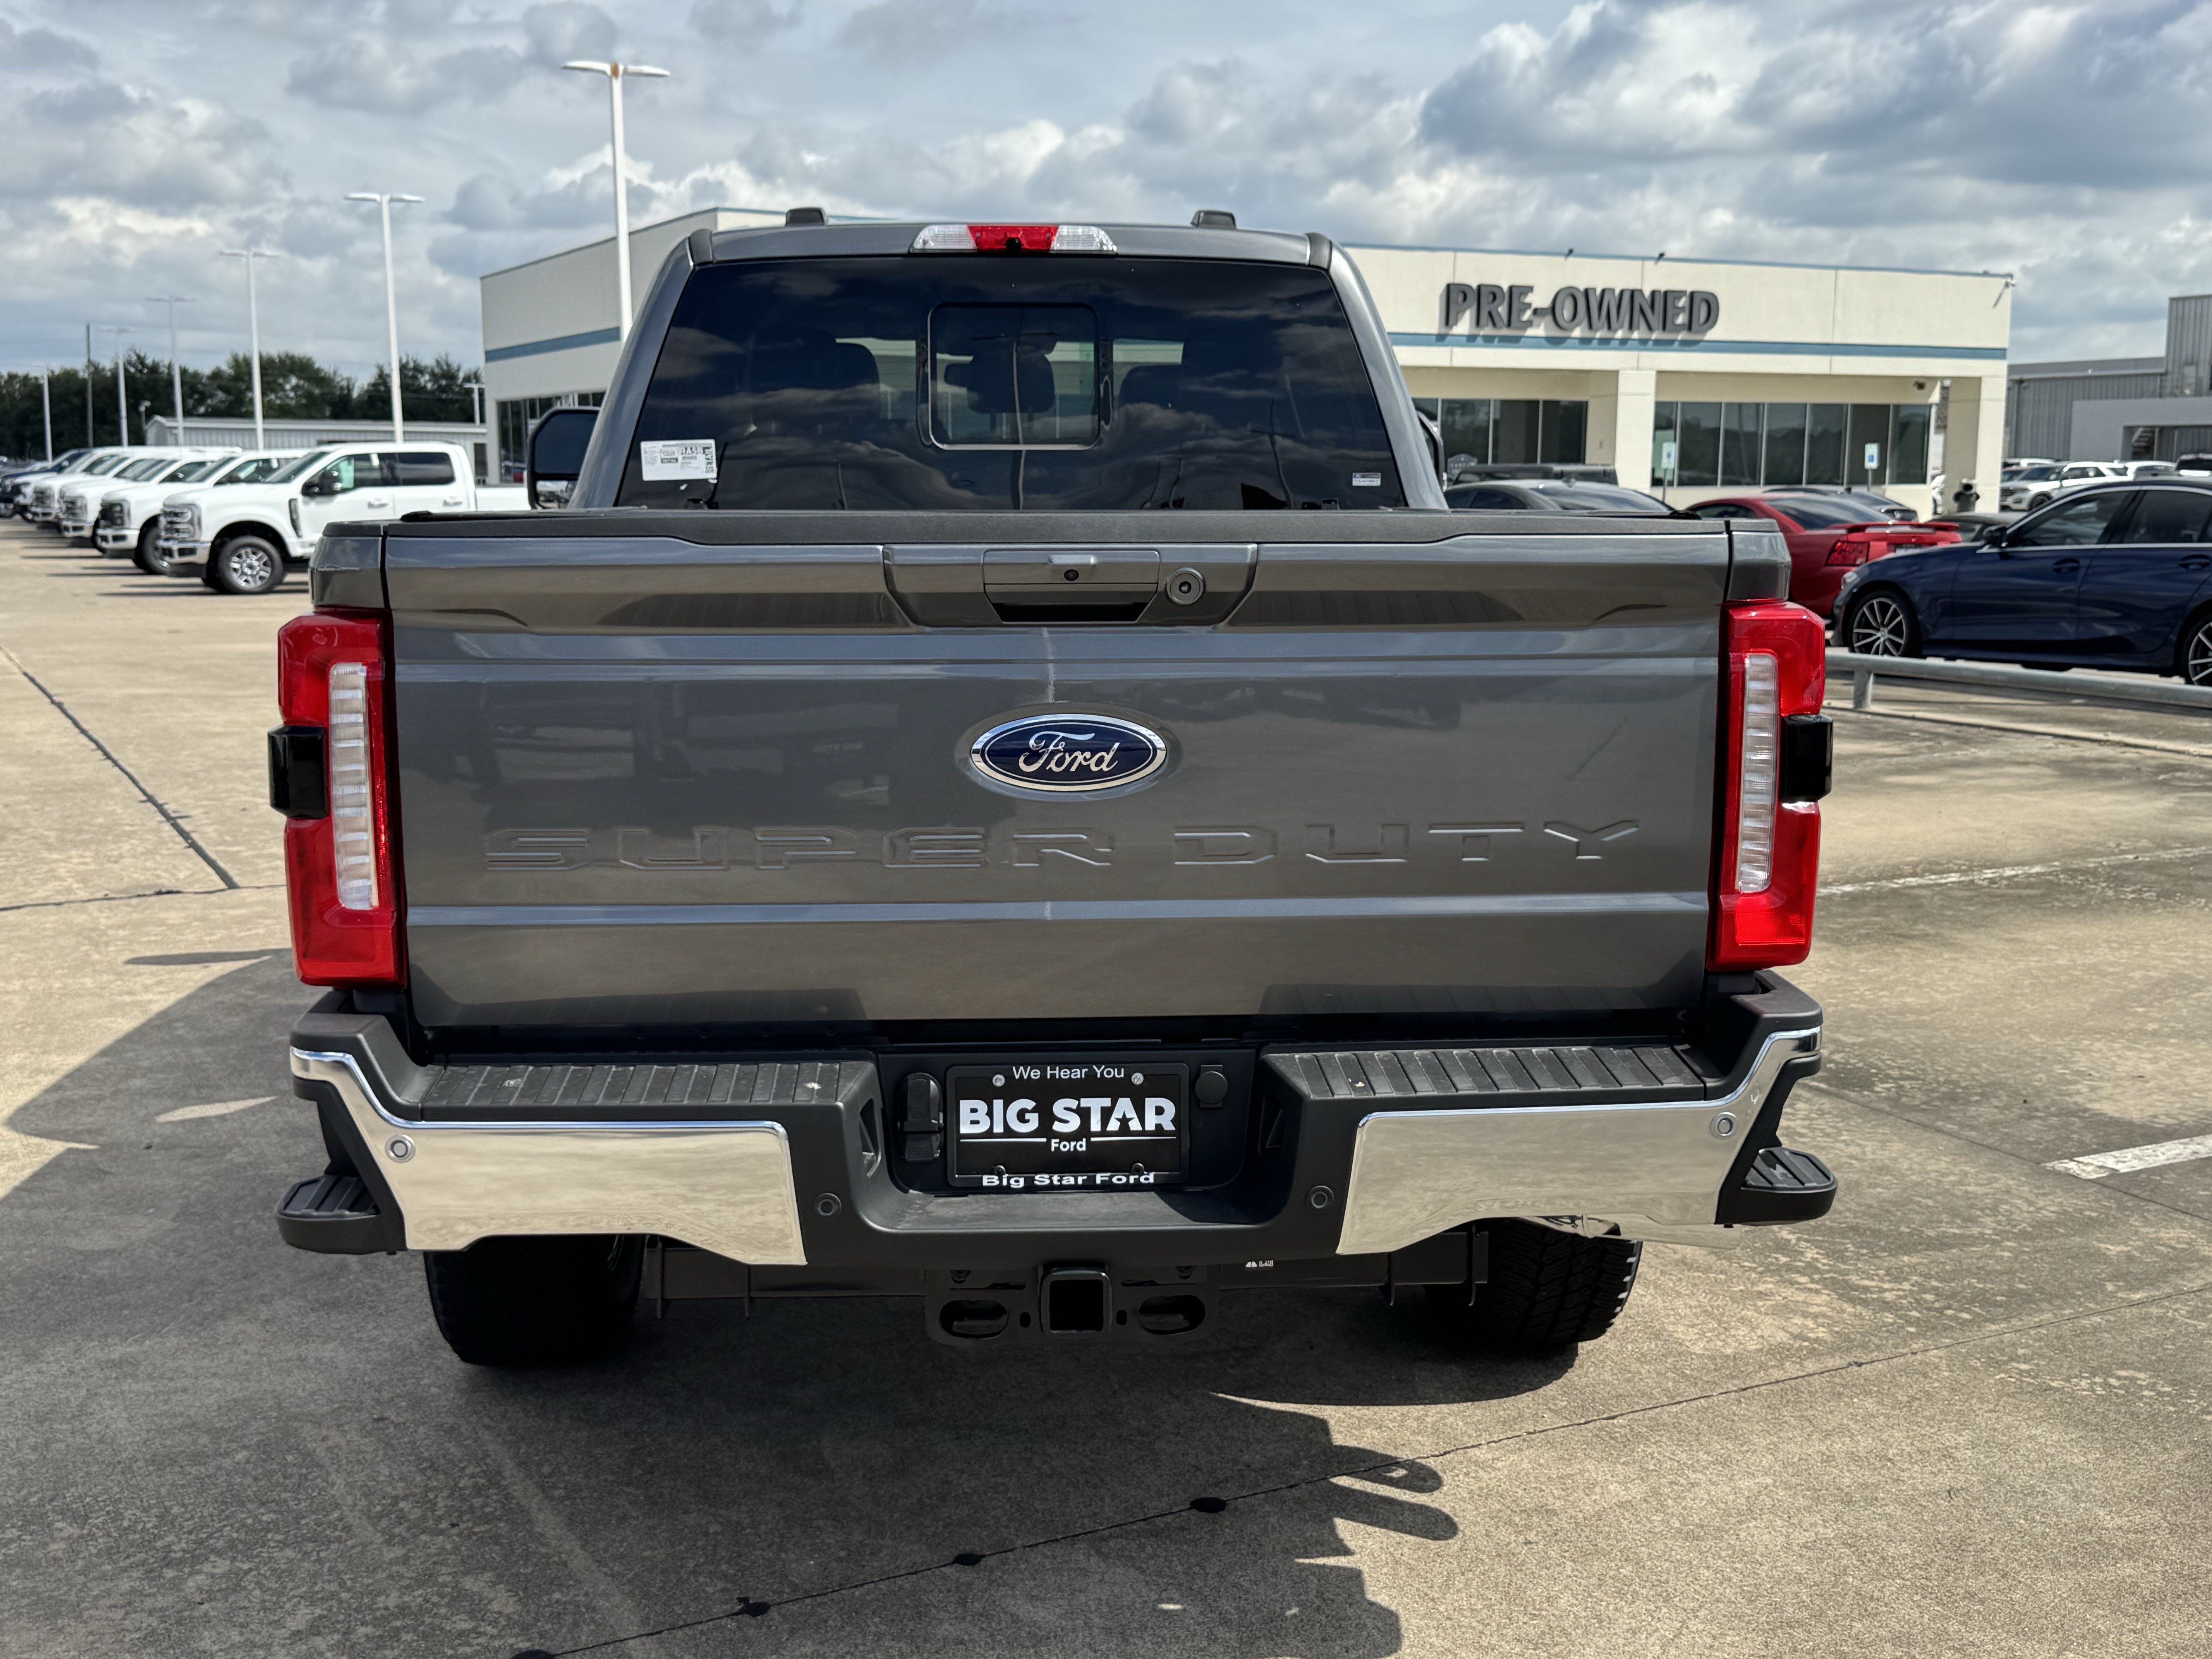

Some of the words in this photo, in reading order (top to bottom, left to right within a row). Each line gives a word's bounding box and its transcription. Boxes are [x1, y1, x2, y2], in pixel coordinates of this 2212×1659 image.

[1446, 283, 1719, 333] PRE-OWNED
[1018, 731, 1120, 772] Ford
[485, 826, 1115, 871] SUPER
[1174, 819, 1639, 865] DUTY
[1012, 1066, 1041, 1079] We
[1047, 1066, 1088, 1079] Hear
[1092, 1065, 1124, 1078] You
[960, 1099, 1039, 1134] BIG
[1052, 1097, 1176, 1133] STAR
[1051, 1138, 1086, 1152] Ford
[982, 1174, 1024, 1188] Big
[1034, 1173, 1087, 1185] Star
[1096, 1172, 1155, 1184] Ford
